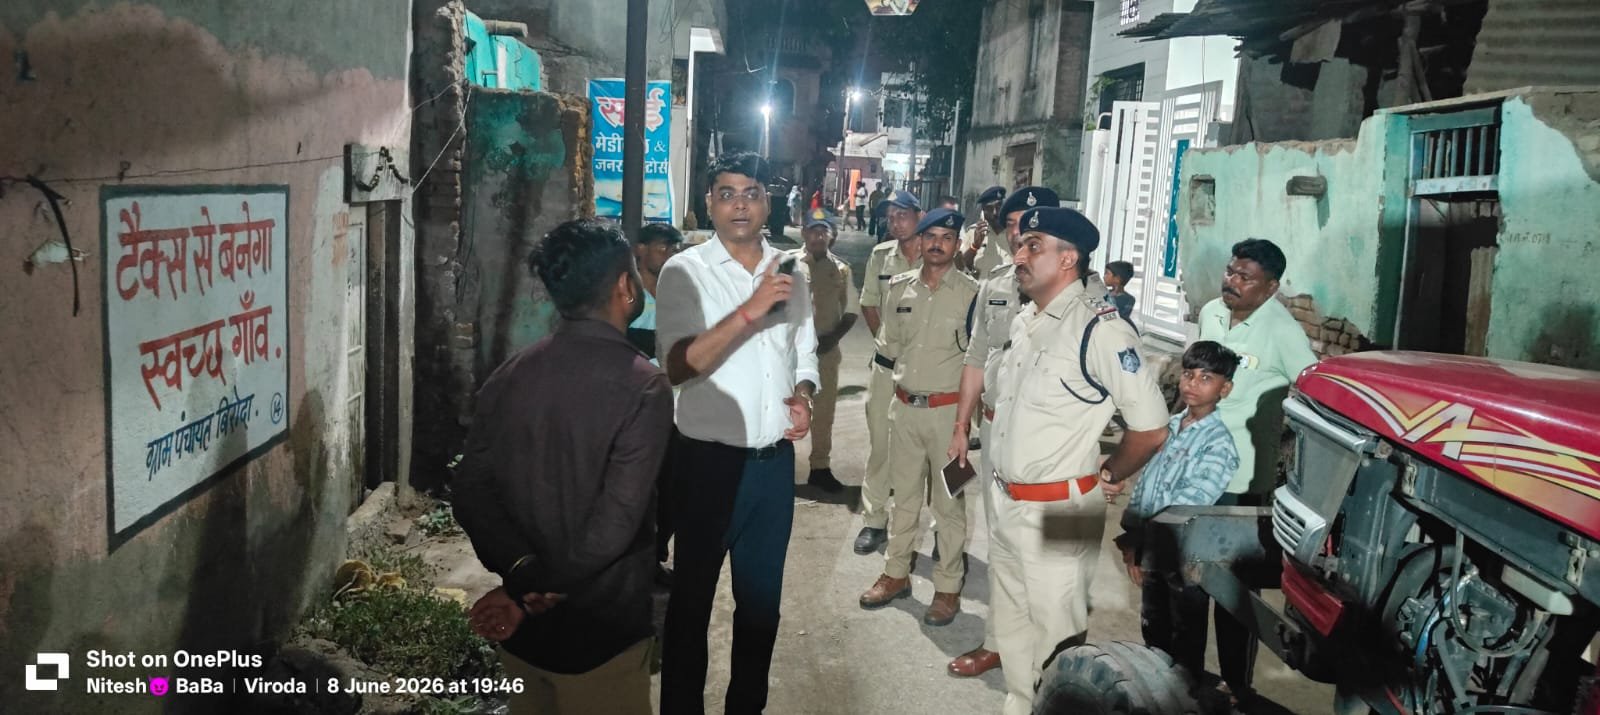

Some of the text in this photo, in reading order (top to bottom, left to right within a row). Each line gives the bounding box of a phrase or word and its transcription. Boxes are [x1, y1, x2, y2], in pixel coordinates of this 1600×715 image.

[595, 87, 666, 132] सई
[595, 158, 624, 172] जनर
[654, 140, 666, 152] &
[116, 201, 275, 301] टैक्स से बनेगा
[139, 318, 227, 411] स्वच्छ
[146, 432, 174, 481] ग्राम
[175, 410, 214, 459] पंचायत
